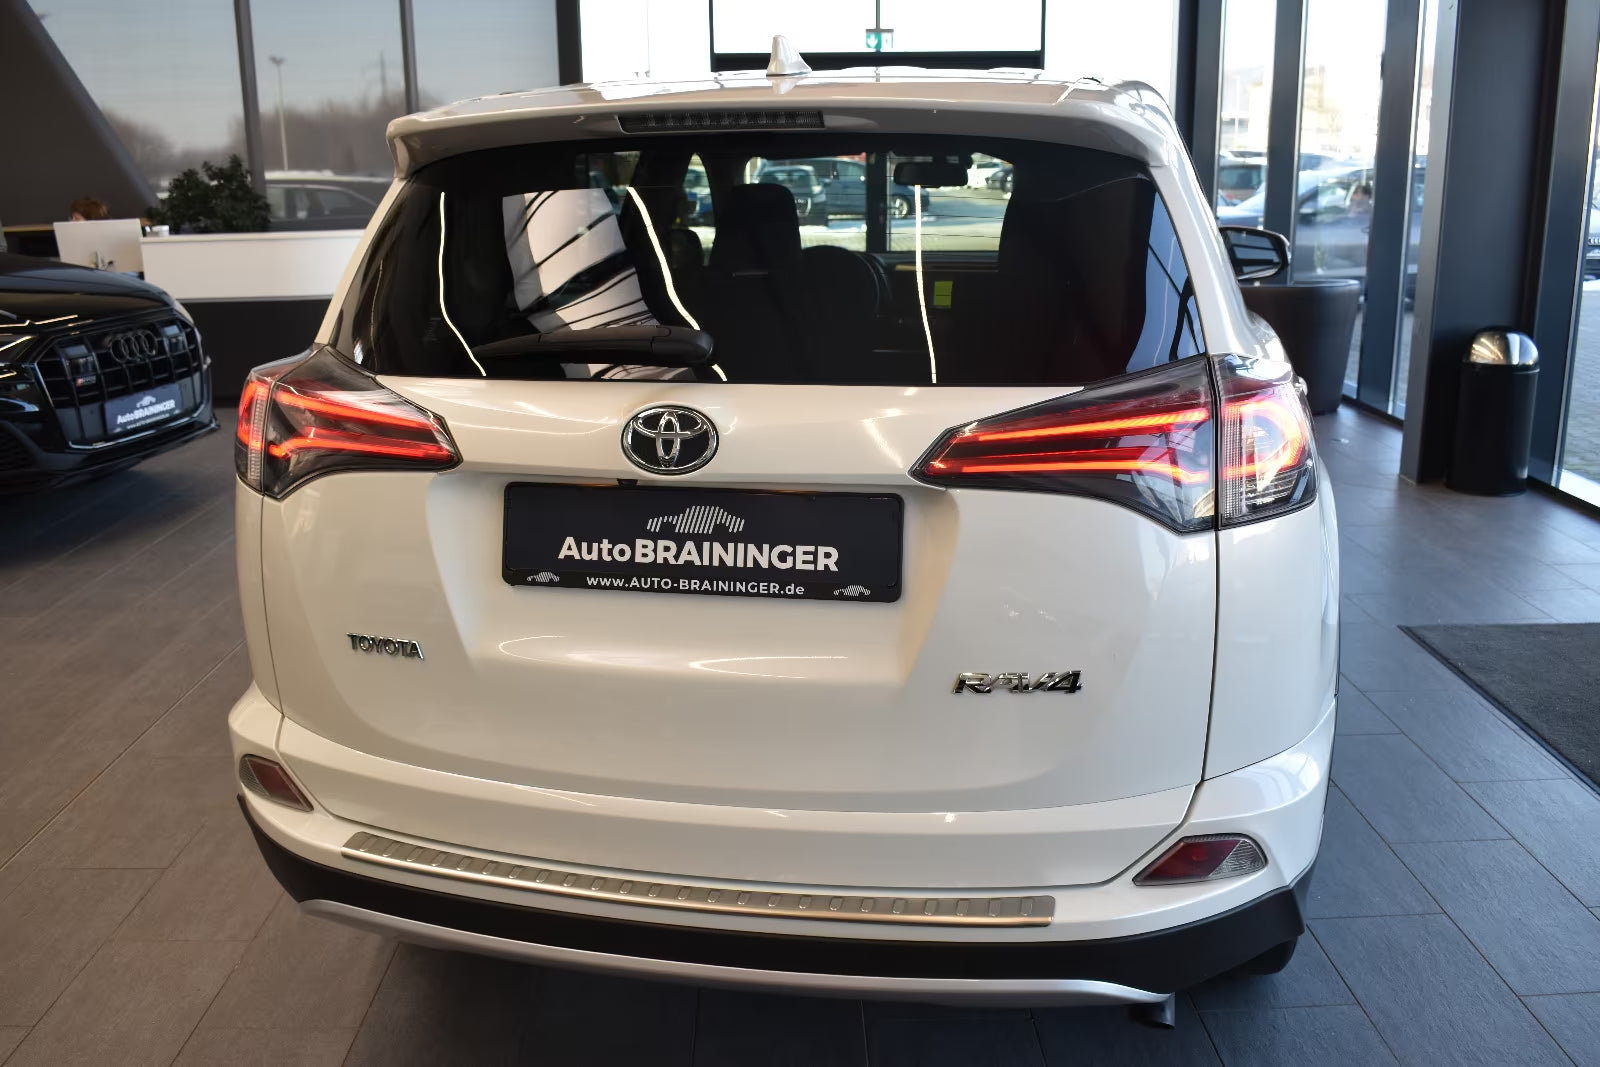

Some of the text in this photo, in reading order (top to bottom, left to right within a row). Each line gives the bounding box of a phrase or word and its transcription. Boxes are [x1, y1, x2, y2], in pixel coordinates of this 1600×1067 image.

[586, 576, 805, 595] www.AUTO-BRAININGER.de
[346, 632, 424, 660] TOYOTA
[952, 670, 1083, 694] RAV4
